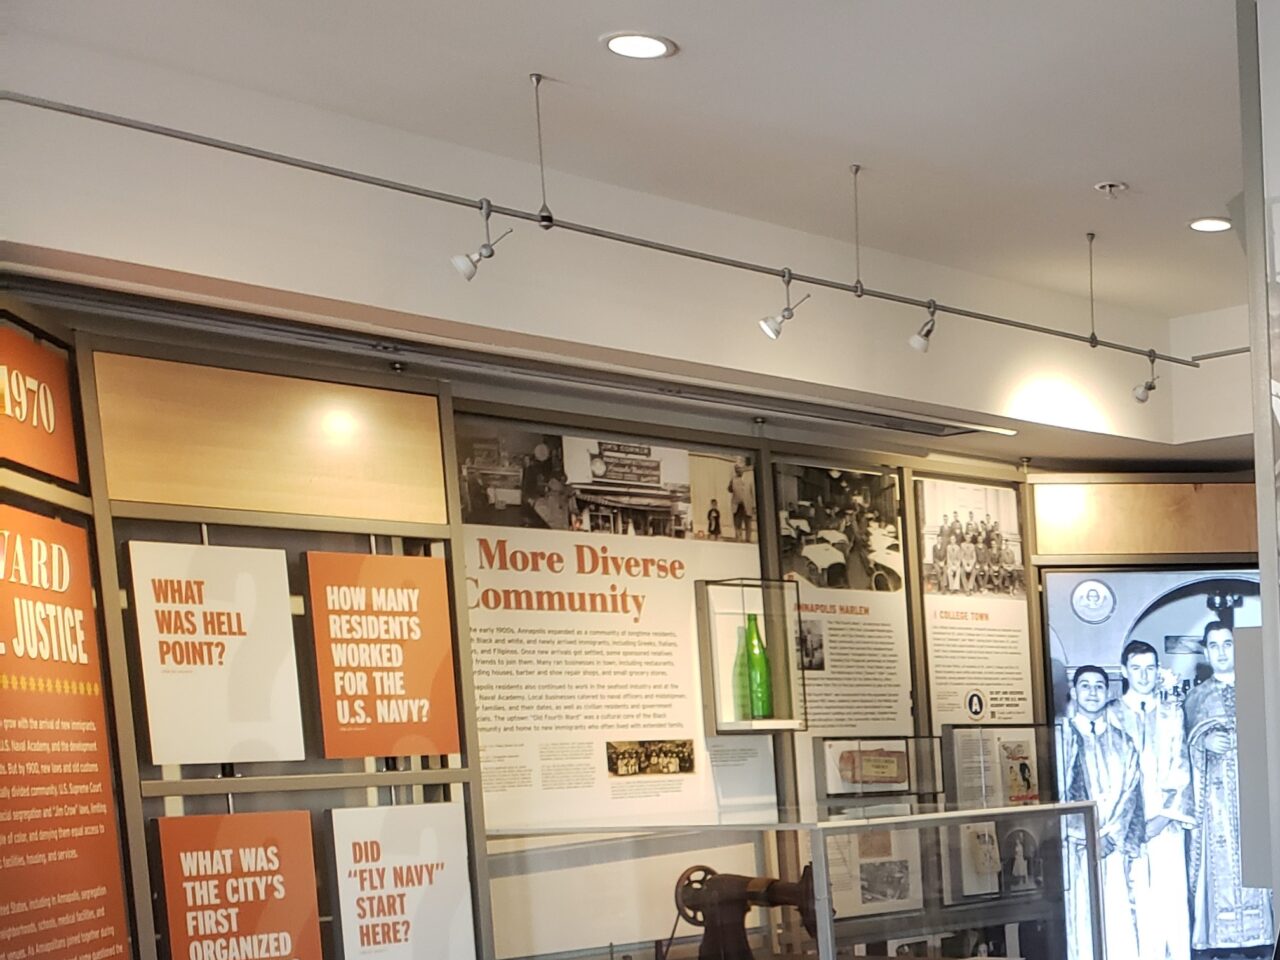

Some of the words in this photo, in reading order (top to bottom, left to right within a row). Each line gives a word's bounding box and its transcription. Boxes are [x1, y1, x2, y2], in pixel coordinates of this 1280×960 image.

[0, 365, 55, 434] 1970
[476, 538, 564, 573] More
[574, 544, 685, 579] Diverse
[151, 578, 205, 605] WHAT
[326, 585, 366, 611] HOW
[372, 588, 419, 612] MANY
[465, 577, 646, 623] Community
[12, 597, 89, 665] JUSTICE
[155, 609, 197, 635] WAS
[203, 611, 247, 636] HELL
[329, 614, 422, 640] RESIDENTS
[158, 640, 226, 666] POINT?
[330, 643, 403, 668] WORKED
[334, 671, 368, 696] FOR
[373, 671, 405, 695] THE
[336, 700, 372, 724] U.S.
[376, 699, 430, 723] NAVY?
[180, 850, 233, 877] WHAT
[239, 846, 280, 872] WAS
[352, 841, 381, 864] DID
[183, 879, 220, 907] THE
[226, 875, 286, 903] CITY'S
[355, 893, 407, 919] START
[186, 908, 239, 936] FIRST
[359, 920, 411, 948] HERE?
